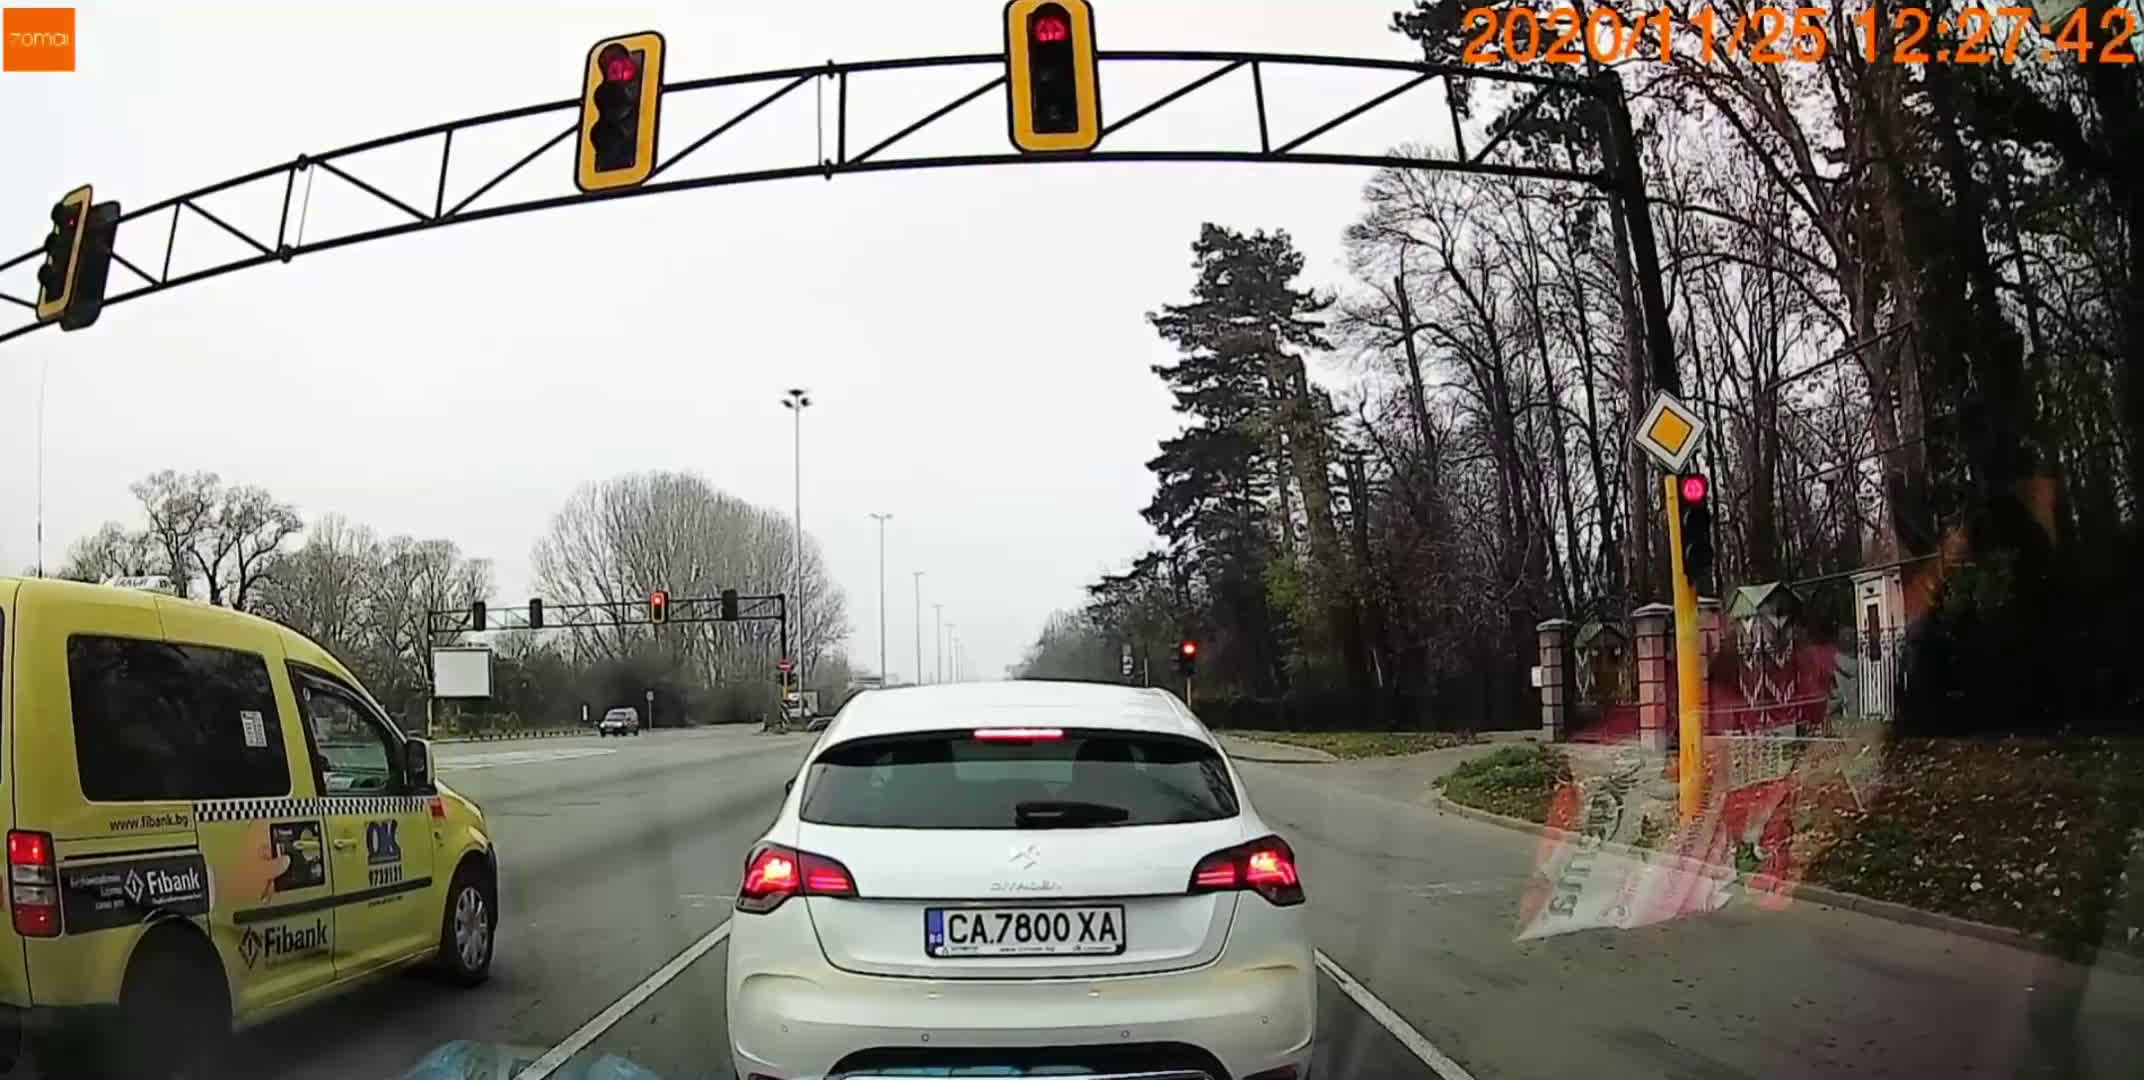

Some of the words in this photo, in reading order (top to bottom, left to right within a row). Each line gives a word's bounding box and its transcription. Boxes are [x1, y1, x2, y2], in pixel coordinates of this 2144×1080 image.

[110, 814, 188, 831] www.fibank.bg
[146, 867, 201, 895] Fibank
[264, 918, 328, 957] Fibank
[1078, 911, 1117, 942] XA
